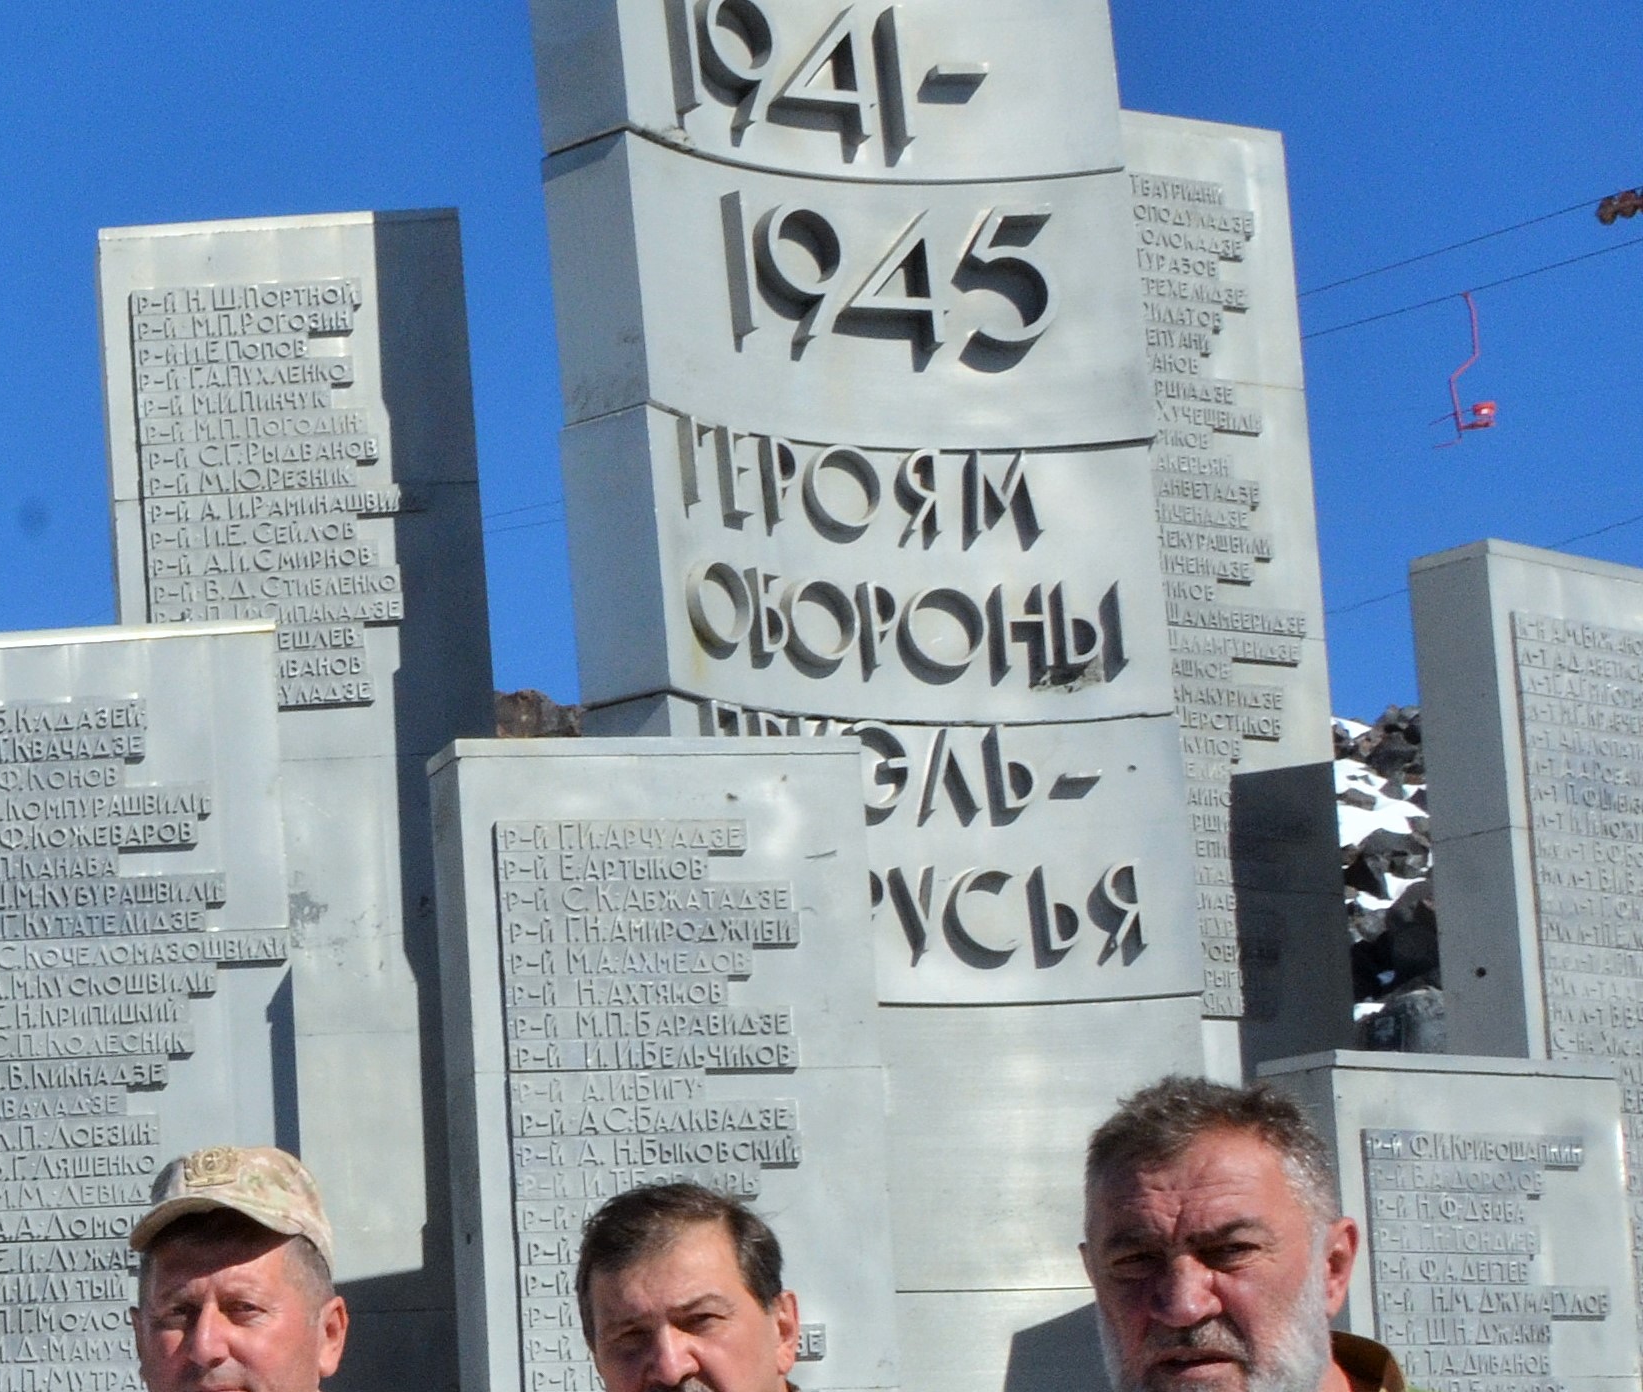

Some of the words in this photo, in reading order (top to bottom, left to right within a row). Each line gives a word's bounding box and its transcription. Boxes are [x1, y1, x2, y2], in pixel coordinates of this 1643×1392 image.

[662, 0, 989, 167] 1941-
[719, 190, 1058, 374] 1945
[677, 415, 1043, 551] ГЕРОЯМ
[686, 562, 1128, 687] ОБОРОНЫ
